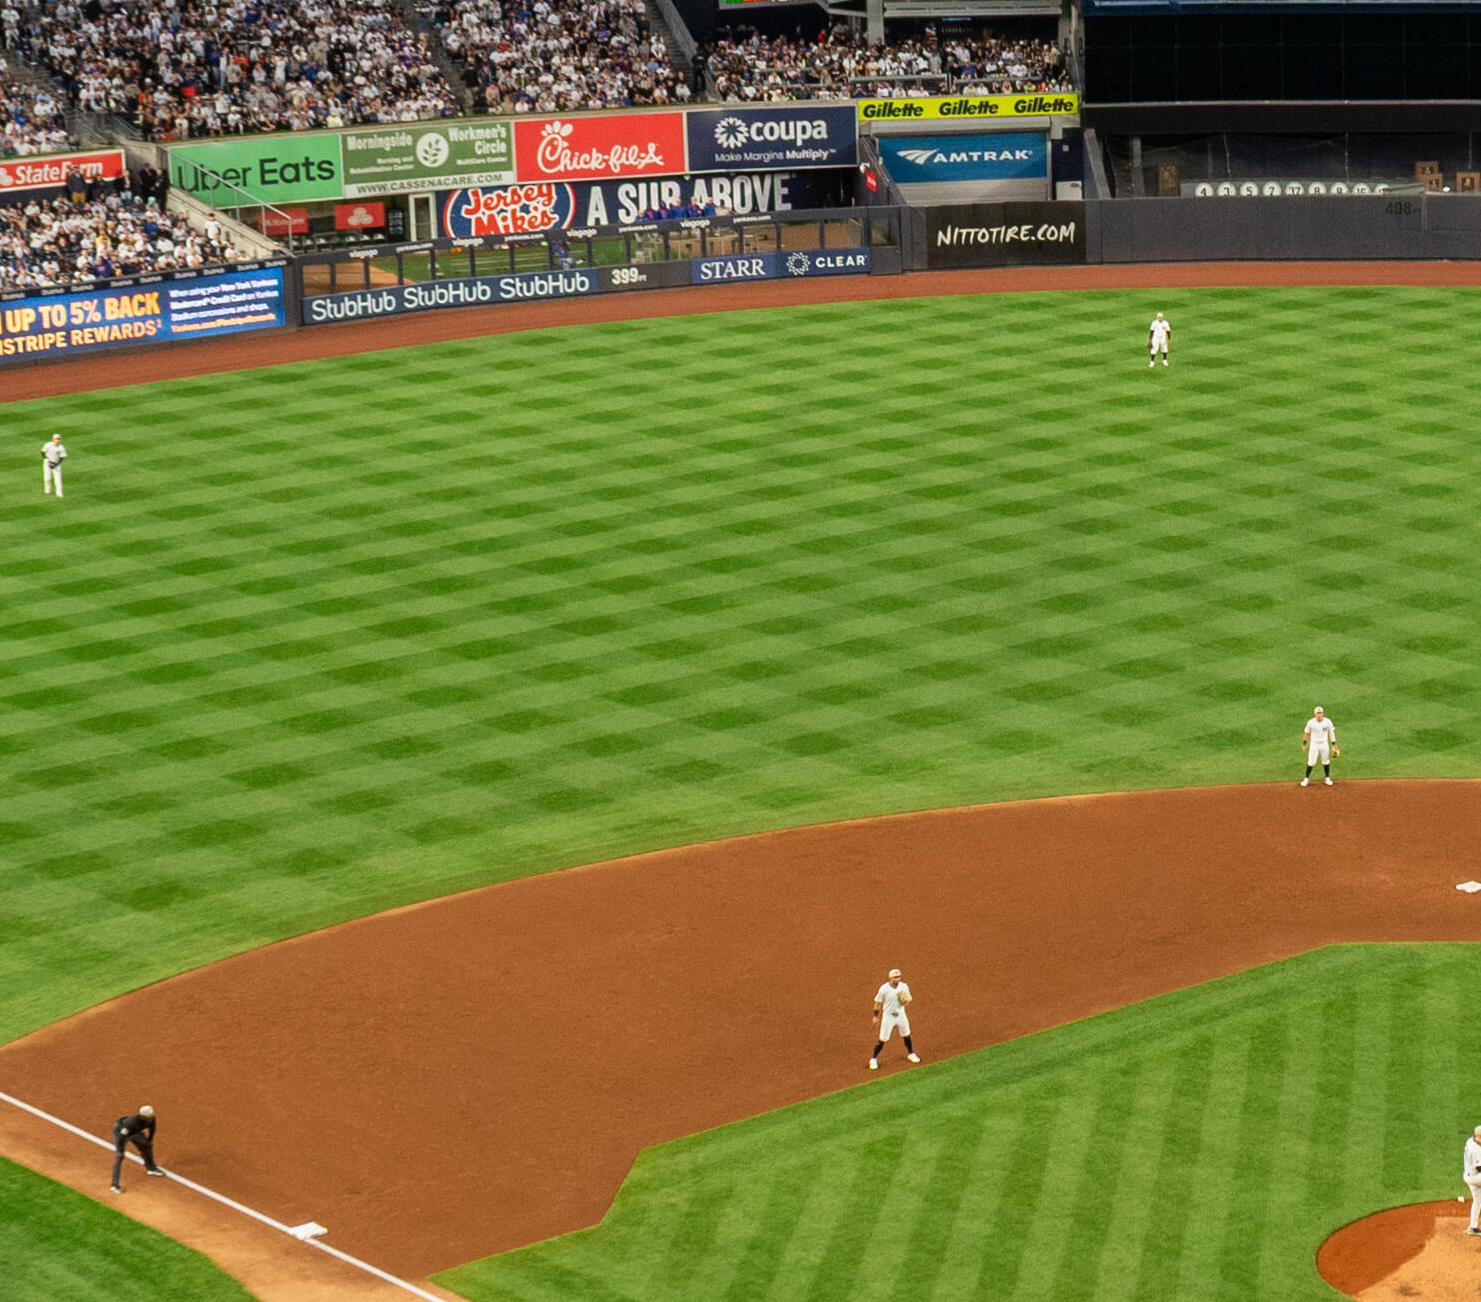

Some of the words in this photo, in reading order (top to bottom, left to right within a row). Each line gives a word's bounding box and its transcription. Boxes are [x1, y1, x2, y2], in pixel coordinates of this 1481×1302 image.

[863, 102, 924, 119] Gillette
[938, 100, 999, 117] Gillette
[1014, 98, 1074, 115] Gillette
[346, 132, 413, 152] Morningside
[749, 118, 828, 147] coupa
[474, 139, 507, 155] Circle
[714, 152, 741, 161] Make
[743, 150, 785, 163] Margins
[785, 148, 829, 162] Multiply
[932, 149, 1030, 164] AMTRAK
[177, 157, 252, 193] Uber
[259, 156, 335, 185] Eats
[357, 173, 503, 195] WWW.CASSENACARE.COM
[936, 221, 1075, 247] NITTOTIRE.COM
[815, 254, 866, 269] CLEAR
[611, 267, 639, 285] 399
[312, 291, 396, 320] StubHub
[403, 283, 491, 307] StubHub
[499, 273, 590, 296] StubHub
[5, 308, 36, 332] UP
[38, 306, 68, 329] TO
[70, 300, 102, 325] 5%
[104, 292, 161, 321] BACK
